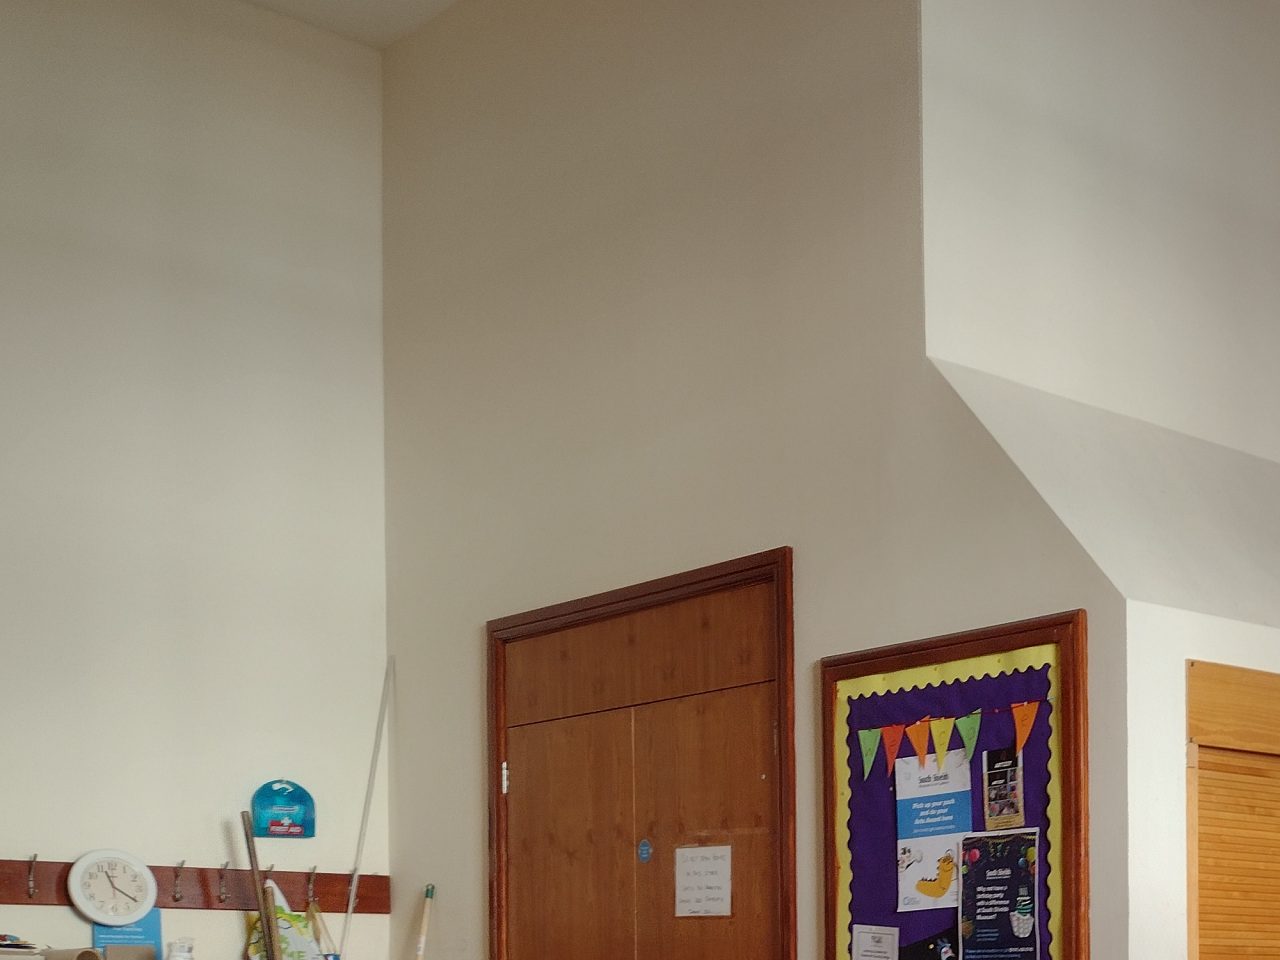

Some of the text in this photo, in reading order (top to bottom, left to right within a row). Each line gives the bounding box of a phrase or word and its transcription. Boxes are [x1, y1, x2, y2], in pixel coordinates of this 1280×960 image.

[96, 864, 104, 873] 11
[107, 862, 117, 870] 12
[88, 872, 98, 880] 10
[111, 904, 118, 912] 6
